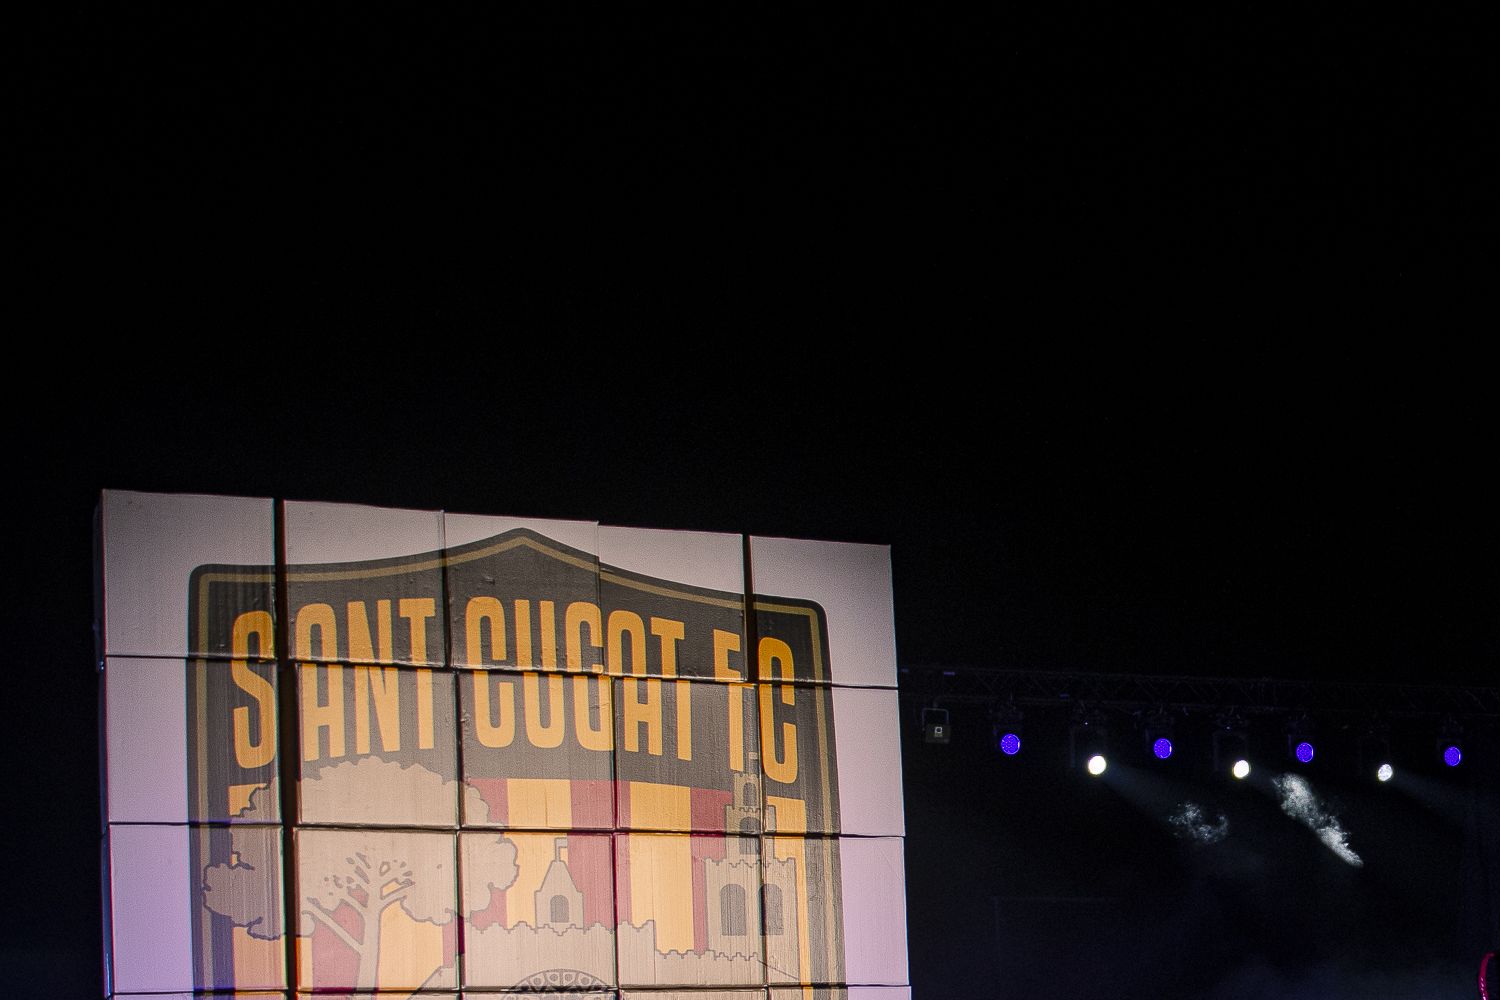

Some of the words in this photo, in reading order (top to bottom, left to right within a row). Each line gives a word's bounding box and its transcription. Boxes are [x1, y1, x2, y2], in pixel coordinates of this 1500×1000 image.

[231, 597, 437, 768] SANT
[465, 595, 693, 762] CUGAT
[713, 628, 797, 784] FC
